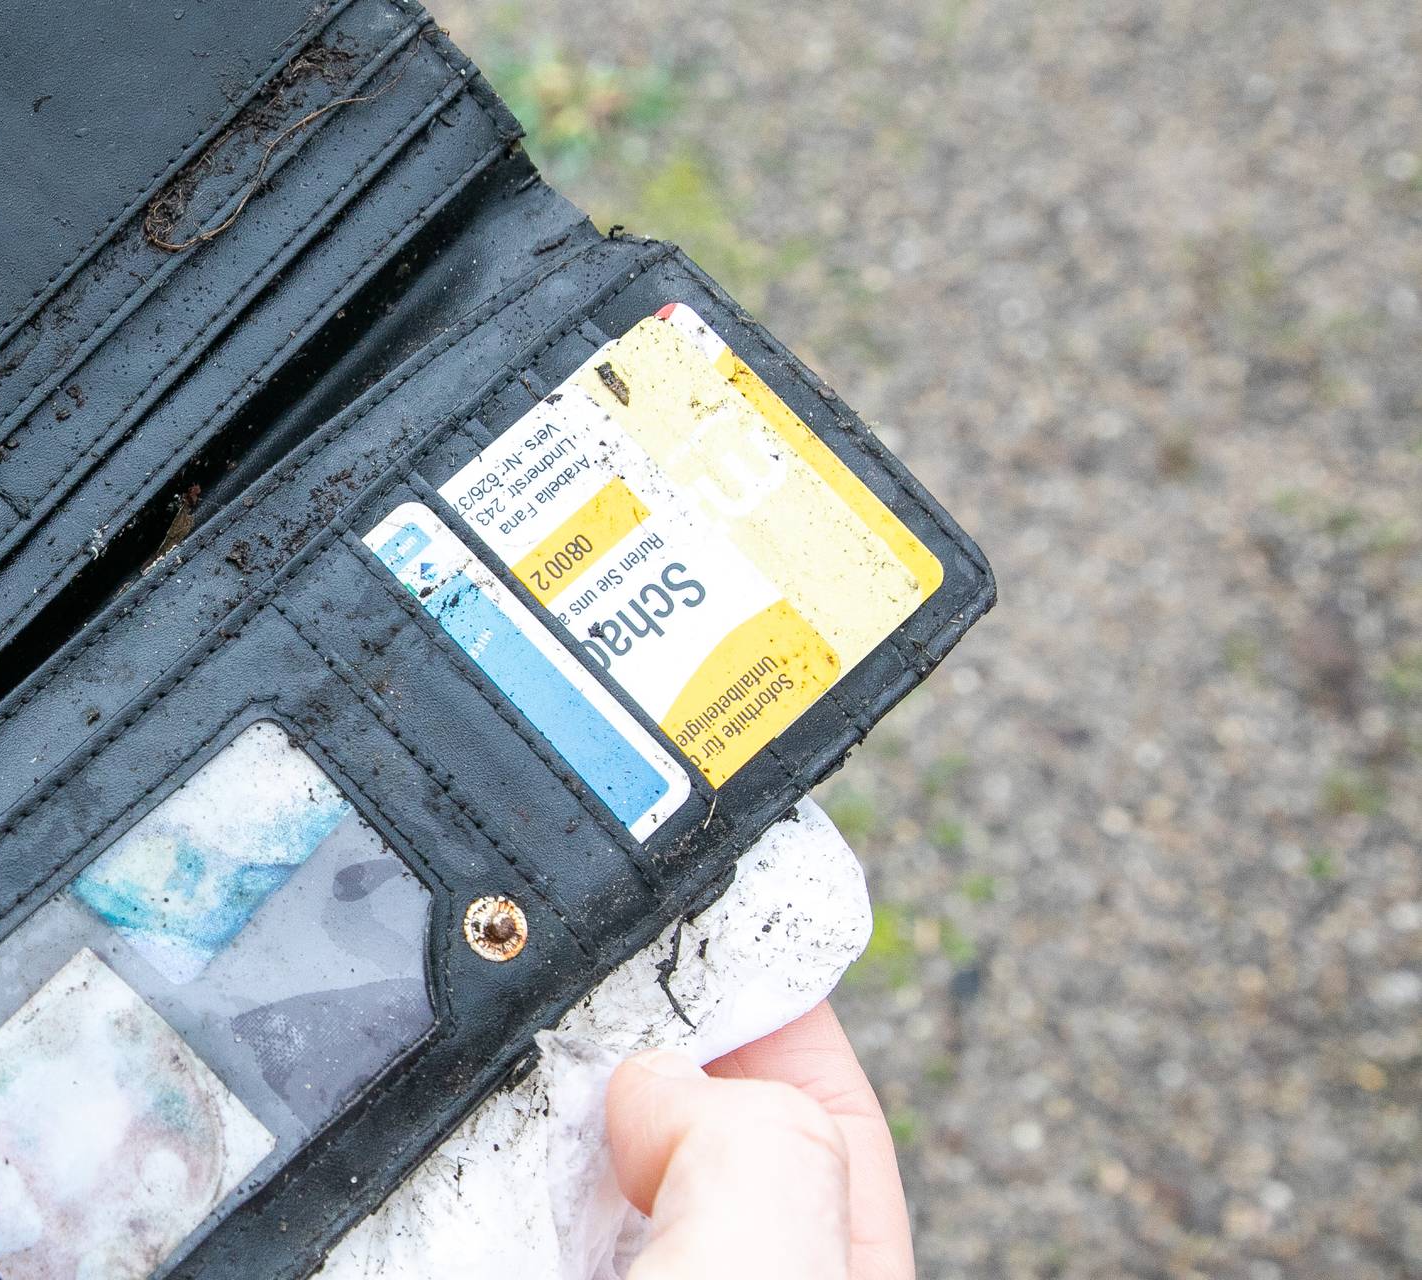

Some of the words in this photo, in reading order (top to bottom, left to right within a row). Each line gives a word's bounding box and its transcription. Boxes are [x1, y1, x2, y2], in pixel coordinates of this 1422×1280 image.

[534, 454, 591, 504] Arabella
[499, 502, 538, 534] Fana
[544, 534, 593, 579] 0800
[619, 532, 665, 571] Rufen
[529, 570, 551, 591] 2
[596, 568, 624, 592] Sie
[569, 589, 598, 616] uns
[675, 656, 779, 747] Unfallbeteiligte
[721, 673, 794, 739] Soforthilfe
[701, 735, 726, 760] für
